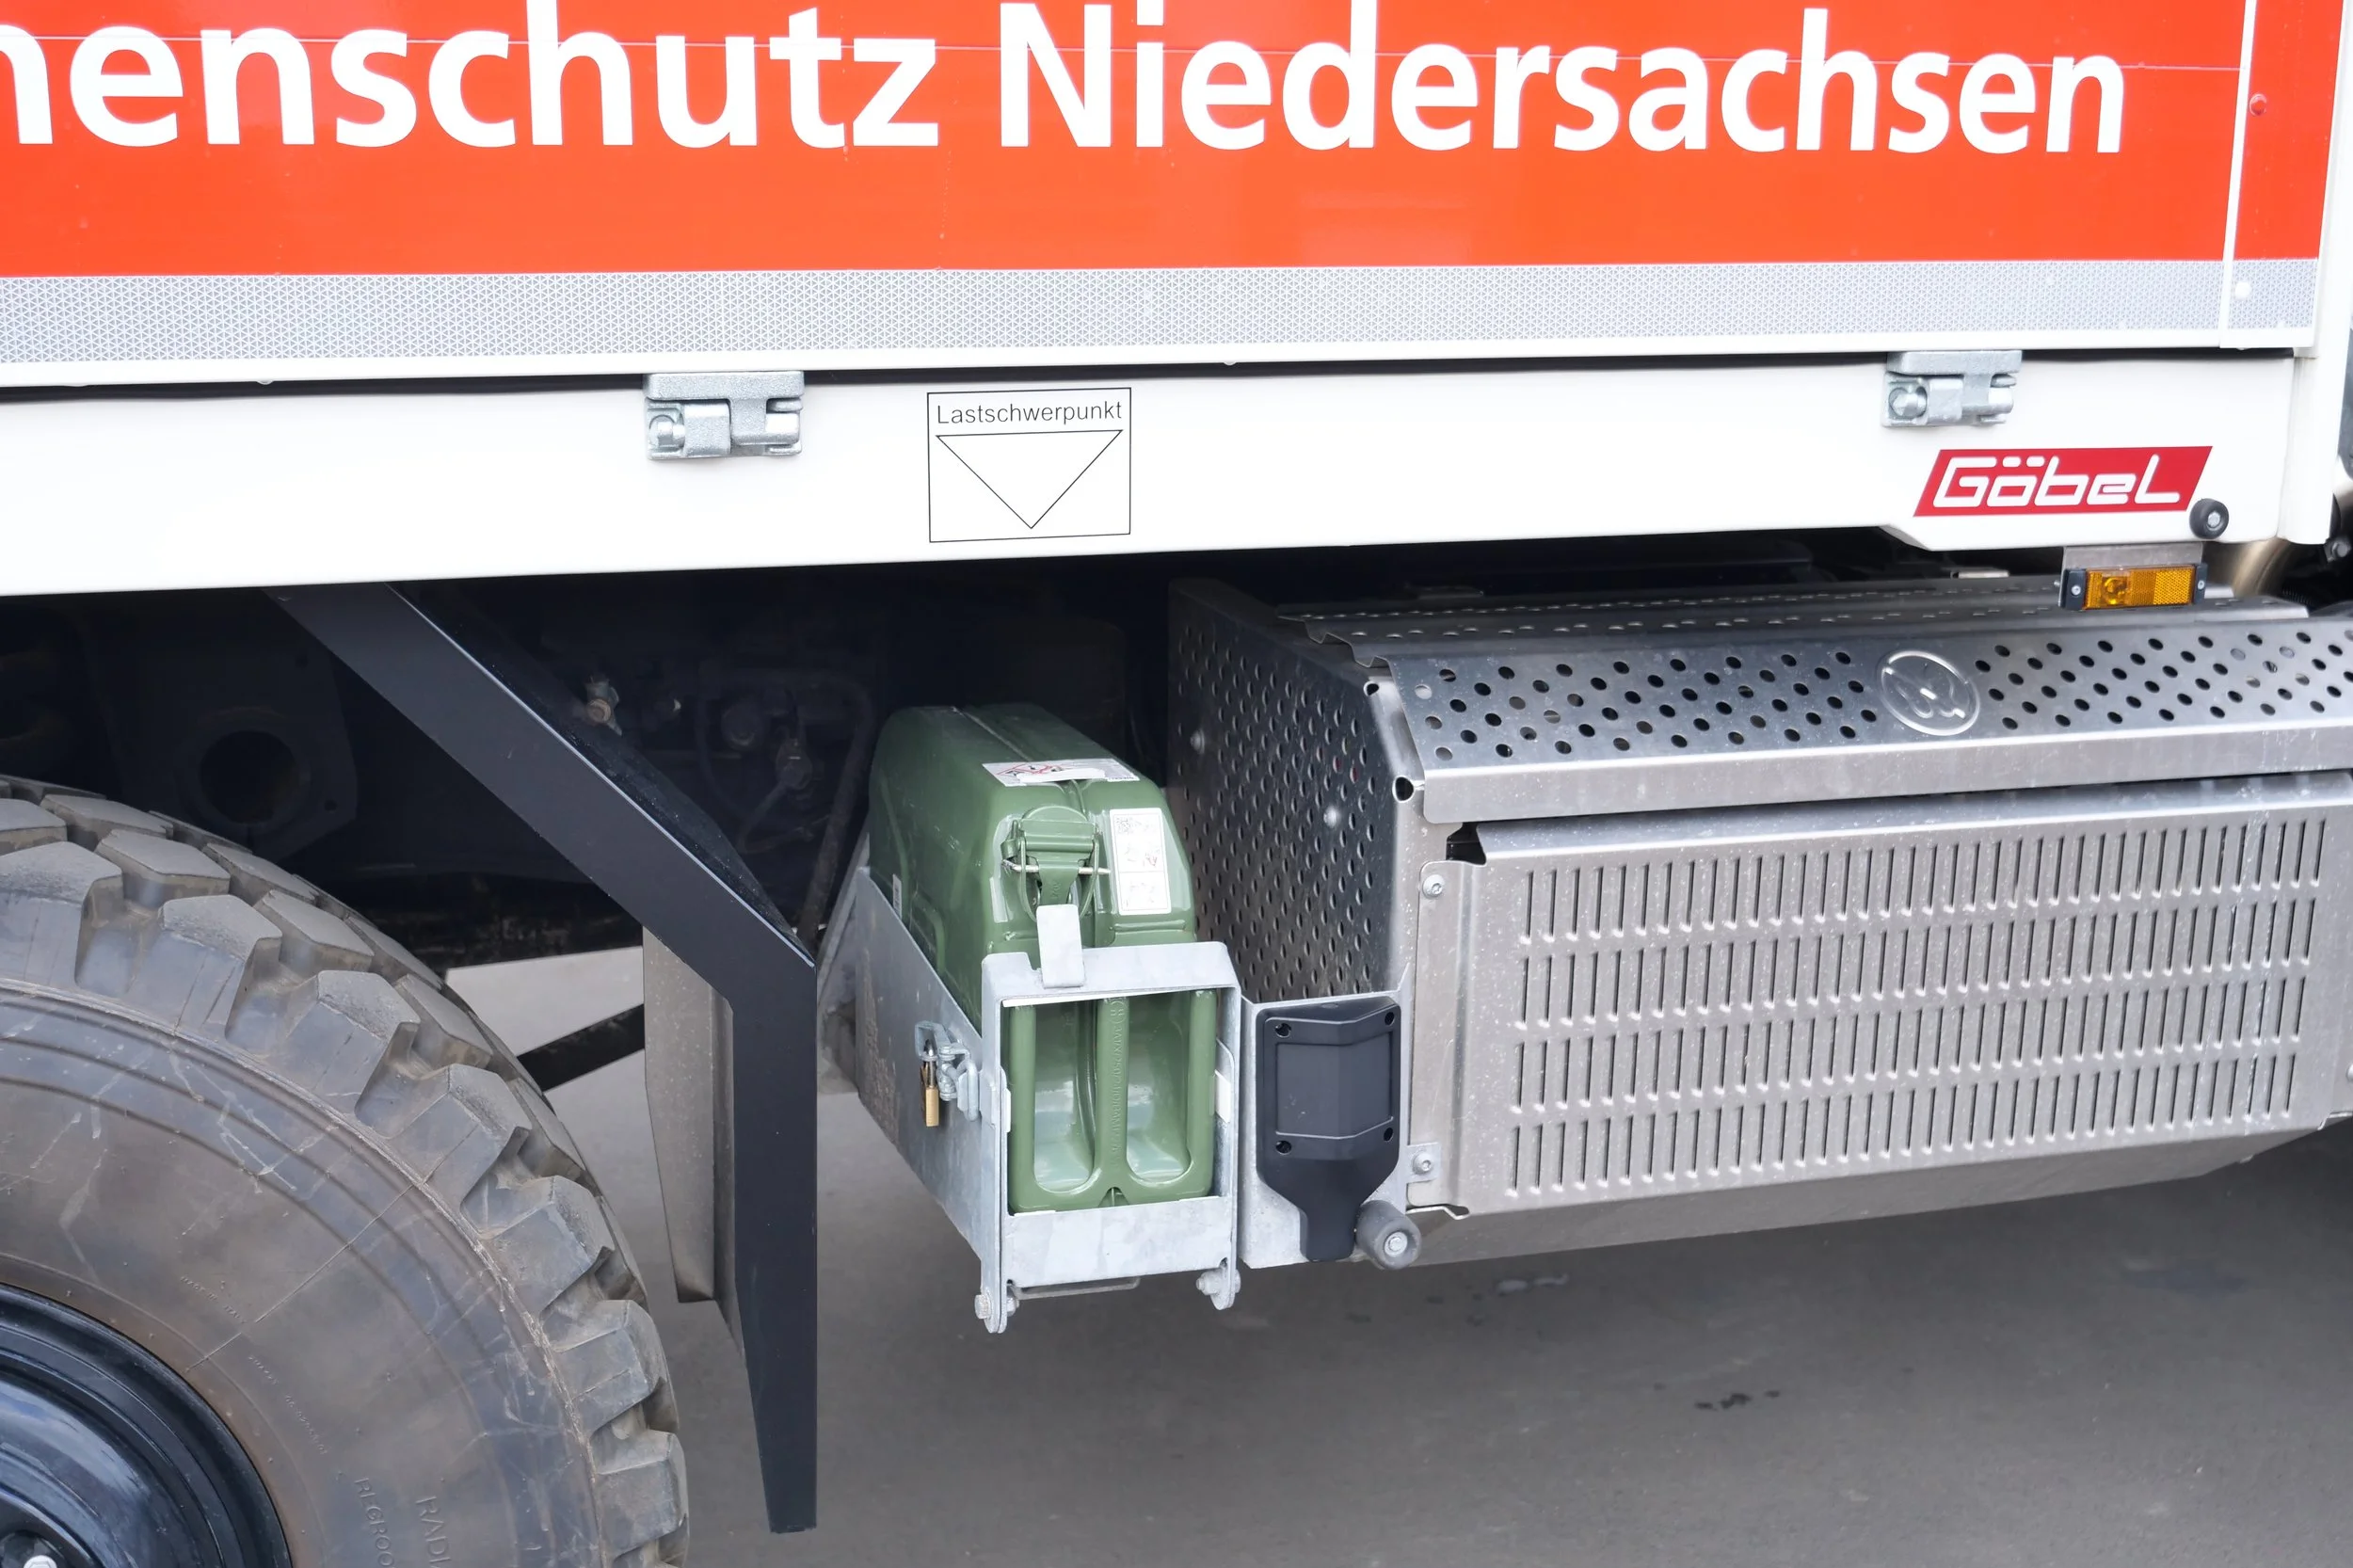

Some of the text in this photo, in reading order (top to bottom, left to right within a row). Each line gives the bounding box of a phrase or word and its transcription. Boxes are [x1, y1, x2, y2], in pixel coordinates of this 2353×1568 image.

[1000, 0, 2125, 153] Niedersachsen
[936, 400, 1123, 425] Lastschwerpunkt
[354, 1477, 397, 1568] REGROO
[415, 1495, 453, 1568] RADI
